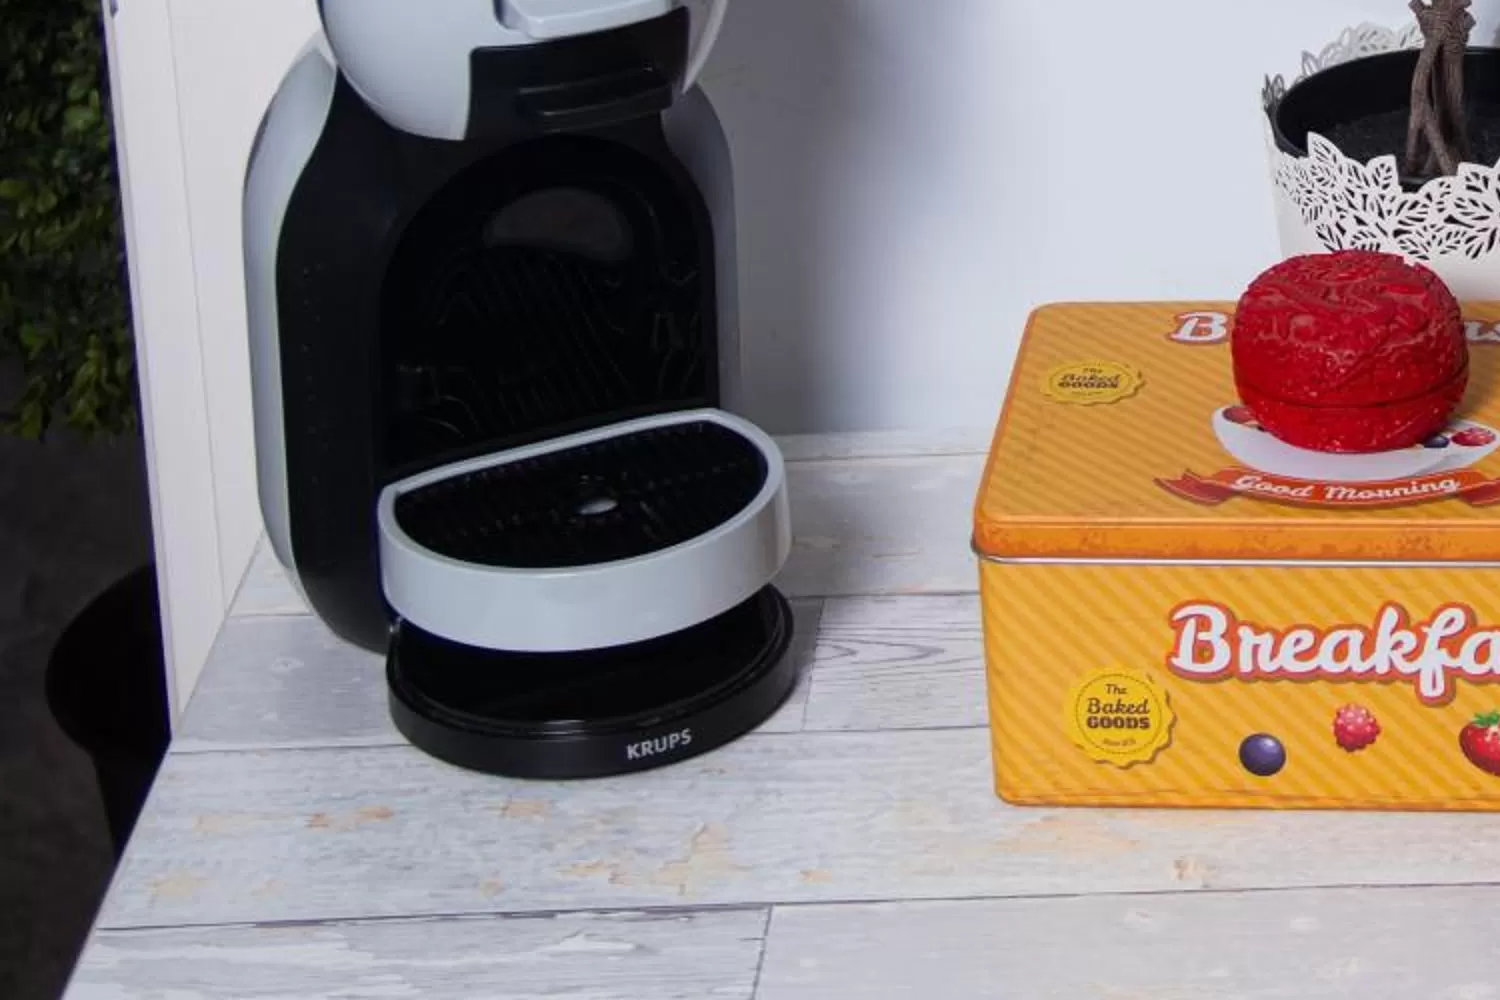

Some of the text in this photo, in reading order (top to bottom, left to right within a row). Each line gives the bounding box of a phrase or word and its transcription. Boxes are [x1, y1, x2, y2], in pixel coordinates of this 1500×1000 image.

[1231, 474, 1461, 501] Good Morning
[1105, 683, 1127, 694] The
[1087, 697, 1150, 714] Baked
[1087, 715, 1150, 729] GOODS
[626, 728, 692, 760] KRUPS
